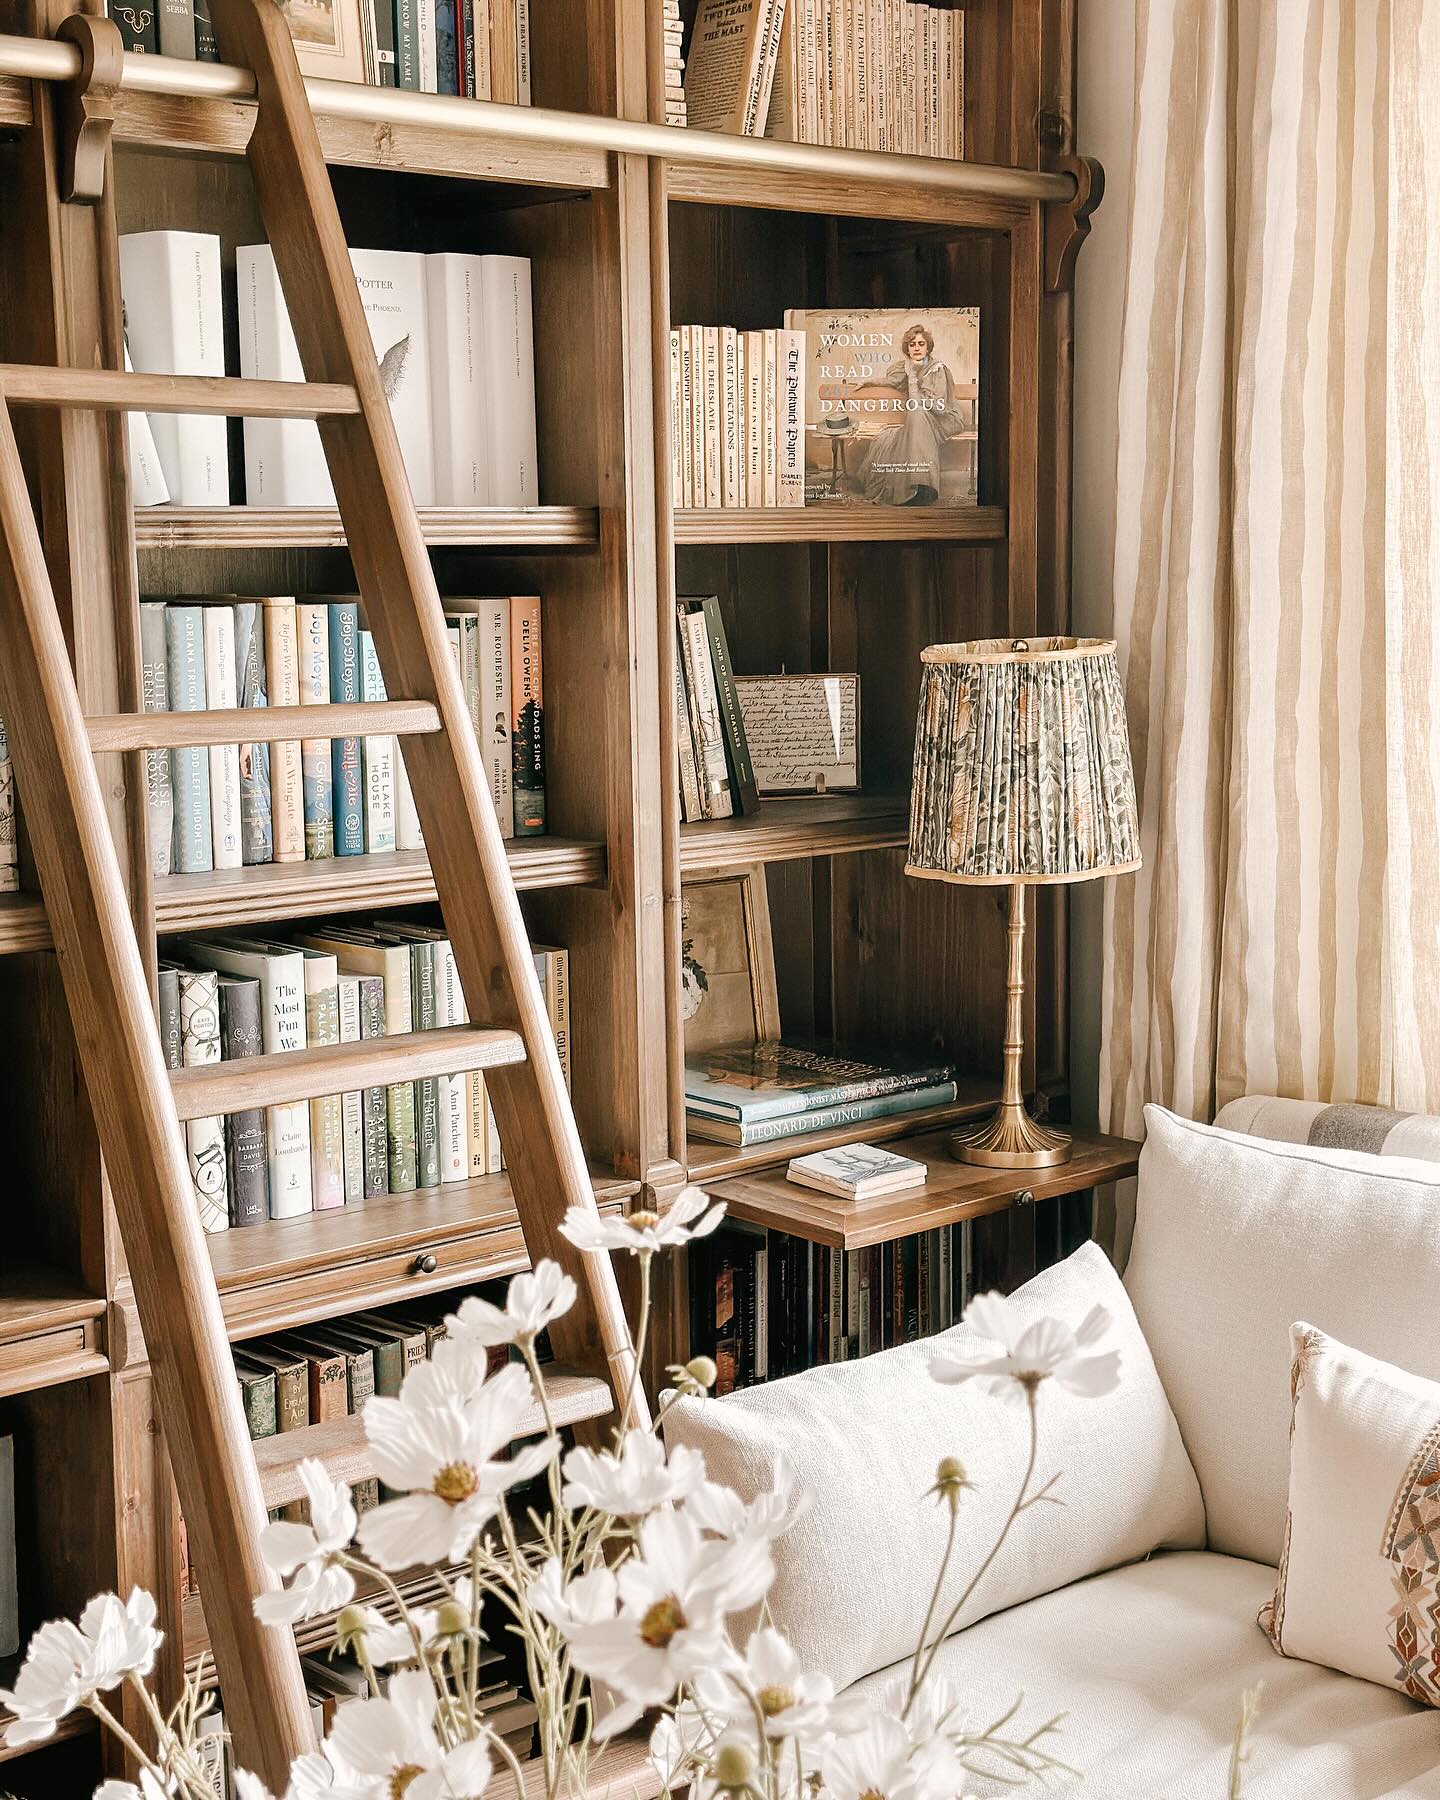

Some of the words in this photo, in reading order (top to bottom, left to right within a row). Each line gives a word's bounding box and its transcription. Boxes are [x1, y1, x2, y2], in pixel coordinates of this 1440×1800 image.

[704, 9, 722, 23] TWO
[724, 3, 753, 17] YEARS
[772, 5, 784, 33] Lord
[403, 34, 410, 49] MY
[703, 31, 719, 42] THE
[721, 24, 744, 38] MAST
[759, 27, 770, 61] YEARS
[769, 34, 779, 58] Jim
[404, 53, 412, 82] NAME
[520, 52, 528, 83] HORSES
[857, 36, 865, 103] PATHFINDER
[751, 90, 759, 110] THE
[707, 344, 715, 364] THE
[820, 333, 894, 348] WOMEN
[726, 344, 734, 376] GREAT
[788, 349, 799, 373] The
[820, 364, 873, 379] READ
[854, 351, 892, 363] WHO
[707, 369, 716, 431] DEERSLAYER
[727, 379, 735, 450] EXPECTATIONS
[785, 376, 799, 425] Pickwick
[820, 398, 946, 413] DANGEROUS
[785, 428, 799, 468] Papers
[185, 616, 196, 663] ADRIANA
[278, 623, 290, 653] Before
[339, 612, 354, 647] Jojo
[522, 620, 530, 653] DELIA
[531, 608, 539, 647] WHERE
[693, 623, 702, 644] LADY
[283, 655, 292, 669] We
[714, 636, 724, 662] ANNE
[249, 644, 258, 689] TWELVE
[311, 650, 325, 697] Moyes
[341, 647, 356, 702] Moyes
[494, 635, 503, 702] ROCHESTER.
[523, 657, 531, 698] OWENS
[720, 664, 727, 676] OF
[154, 662, 166, 709] SUITE
[283, 672, 292, 695] Were
[723, 680, 733, 710] GREEN
[532, 677, 541, 740] CRAWDADS
[730, 714, 741, 748] GABLES
[381, 753, 389, 778] THE
[533, 743, 541, 771] SING
[192, 772, 201, 797] LEFT
[284, 769, 296, 820] Wingate
[315, 760, 328, 800] Giver
[371, 765, 380, 809] HOUSE
[314, 801, 330, 816] of
[382, 785, 391, 819] LAKE
[193, 801, 203, 845] UNDONE
[317, 817, 329, 851] Stars
[422, 965, 433, 991] Tom
[556, 956, 564, 977] Olive
[275, 985, 297, 997] The
[445, 953, 457, 1026] Commonwealt
[556, 979, 564, 996] Ann
[274, 1002, 299, 1016] Most
[328, 991, 337, 1018] THE
[343, 988, 355, 1033] SECRETS
[422, 995, 433, 1024] Lake
[557, 998, 565, 1022] Burns
[278, 1021, 298, 1032] Fun
[318, 1003, 328, 1045] PALAC
[280, 1038, 298, 1050] We
[556, 1030, 566, 1059] COLD
[405, 1090, 413, 1109] LEA
[450, 1089, 459, 1111] Ann
[472, 1072, 480, 1110] ENDELL
[424, 1098, 436, 1148] Patchett
[451, 1113, 461, 1153] Patchett
[472, 1110, 480, 1139] BERRY
[750, 1118, 807, 1140] LEONARD
[811, 1114, 826, 1127] DE
[830, 1107, 862, 1122] VINCI
[238, 1142, 263, 1152] BARBARA
[243, 1152, 260, 1160] DAVIS
[368, 1120, 377, 1171] HARMEL
[377, 1117, 386, 1169] KRISTIN
[395, 1135, 403, 1166] HENRY
